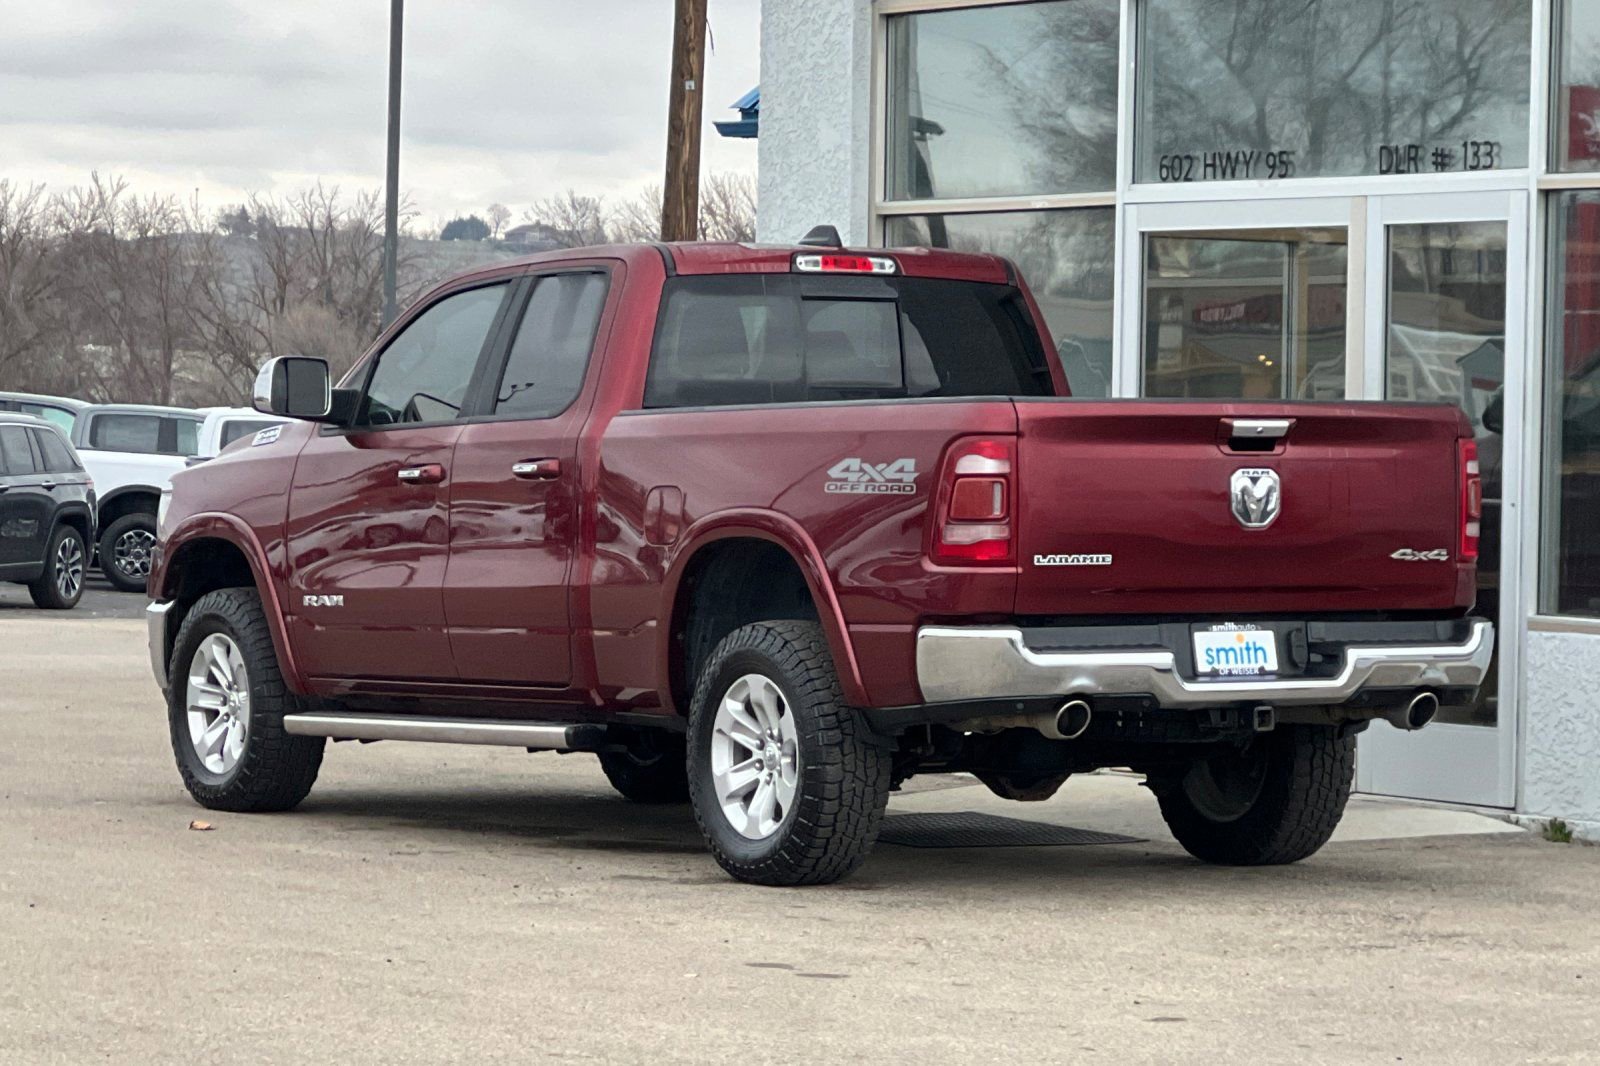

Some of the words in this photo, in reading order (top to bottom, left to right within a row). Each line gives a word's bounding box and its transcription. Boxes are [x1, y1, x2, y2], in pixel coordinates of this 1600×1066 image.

[1379, 144, 1419, 175] DLR
[1432, 147, 1451, 172] #
[1462, 140, 1494, 170] 133
[1160, 154, 1194, 182] 602
[1203, 150, 1254, 180] HWY
[1265, 150, 1289, 179] 95
[826, 482, 861, 493] OFF
[864, 482, 915, 494] ROAD
[1034, 554, 1112, 566] LARAMIE
[303, 594, 344, 607] RAM
[1205, 638, 1268, 665] smith
[1218, 667, 1230, 675] OF
